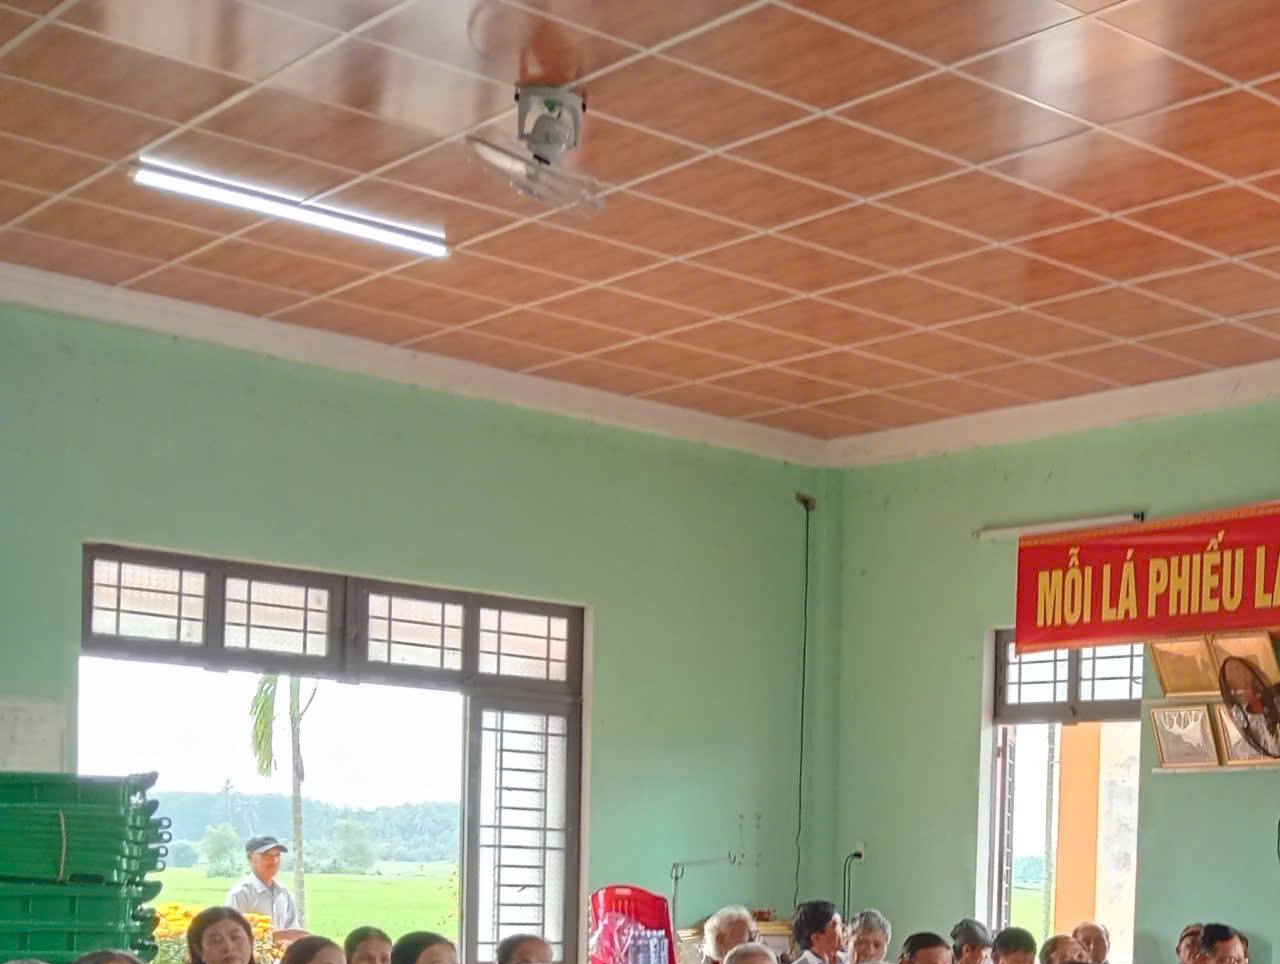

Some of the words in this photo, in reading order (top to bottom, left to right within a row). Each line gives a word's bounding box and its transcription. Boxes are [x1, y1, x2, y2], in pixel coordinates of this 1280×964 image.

[1036, 546, 1092, 628] MỖI
[1101, 548, 1138, 622] LÁ
[1147, 529, 1245, 619] PHIẾU
